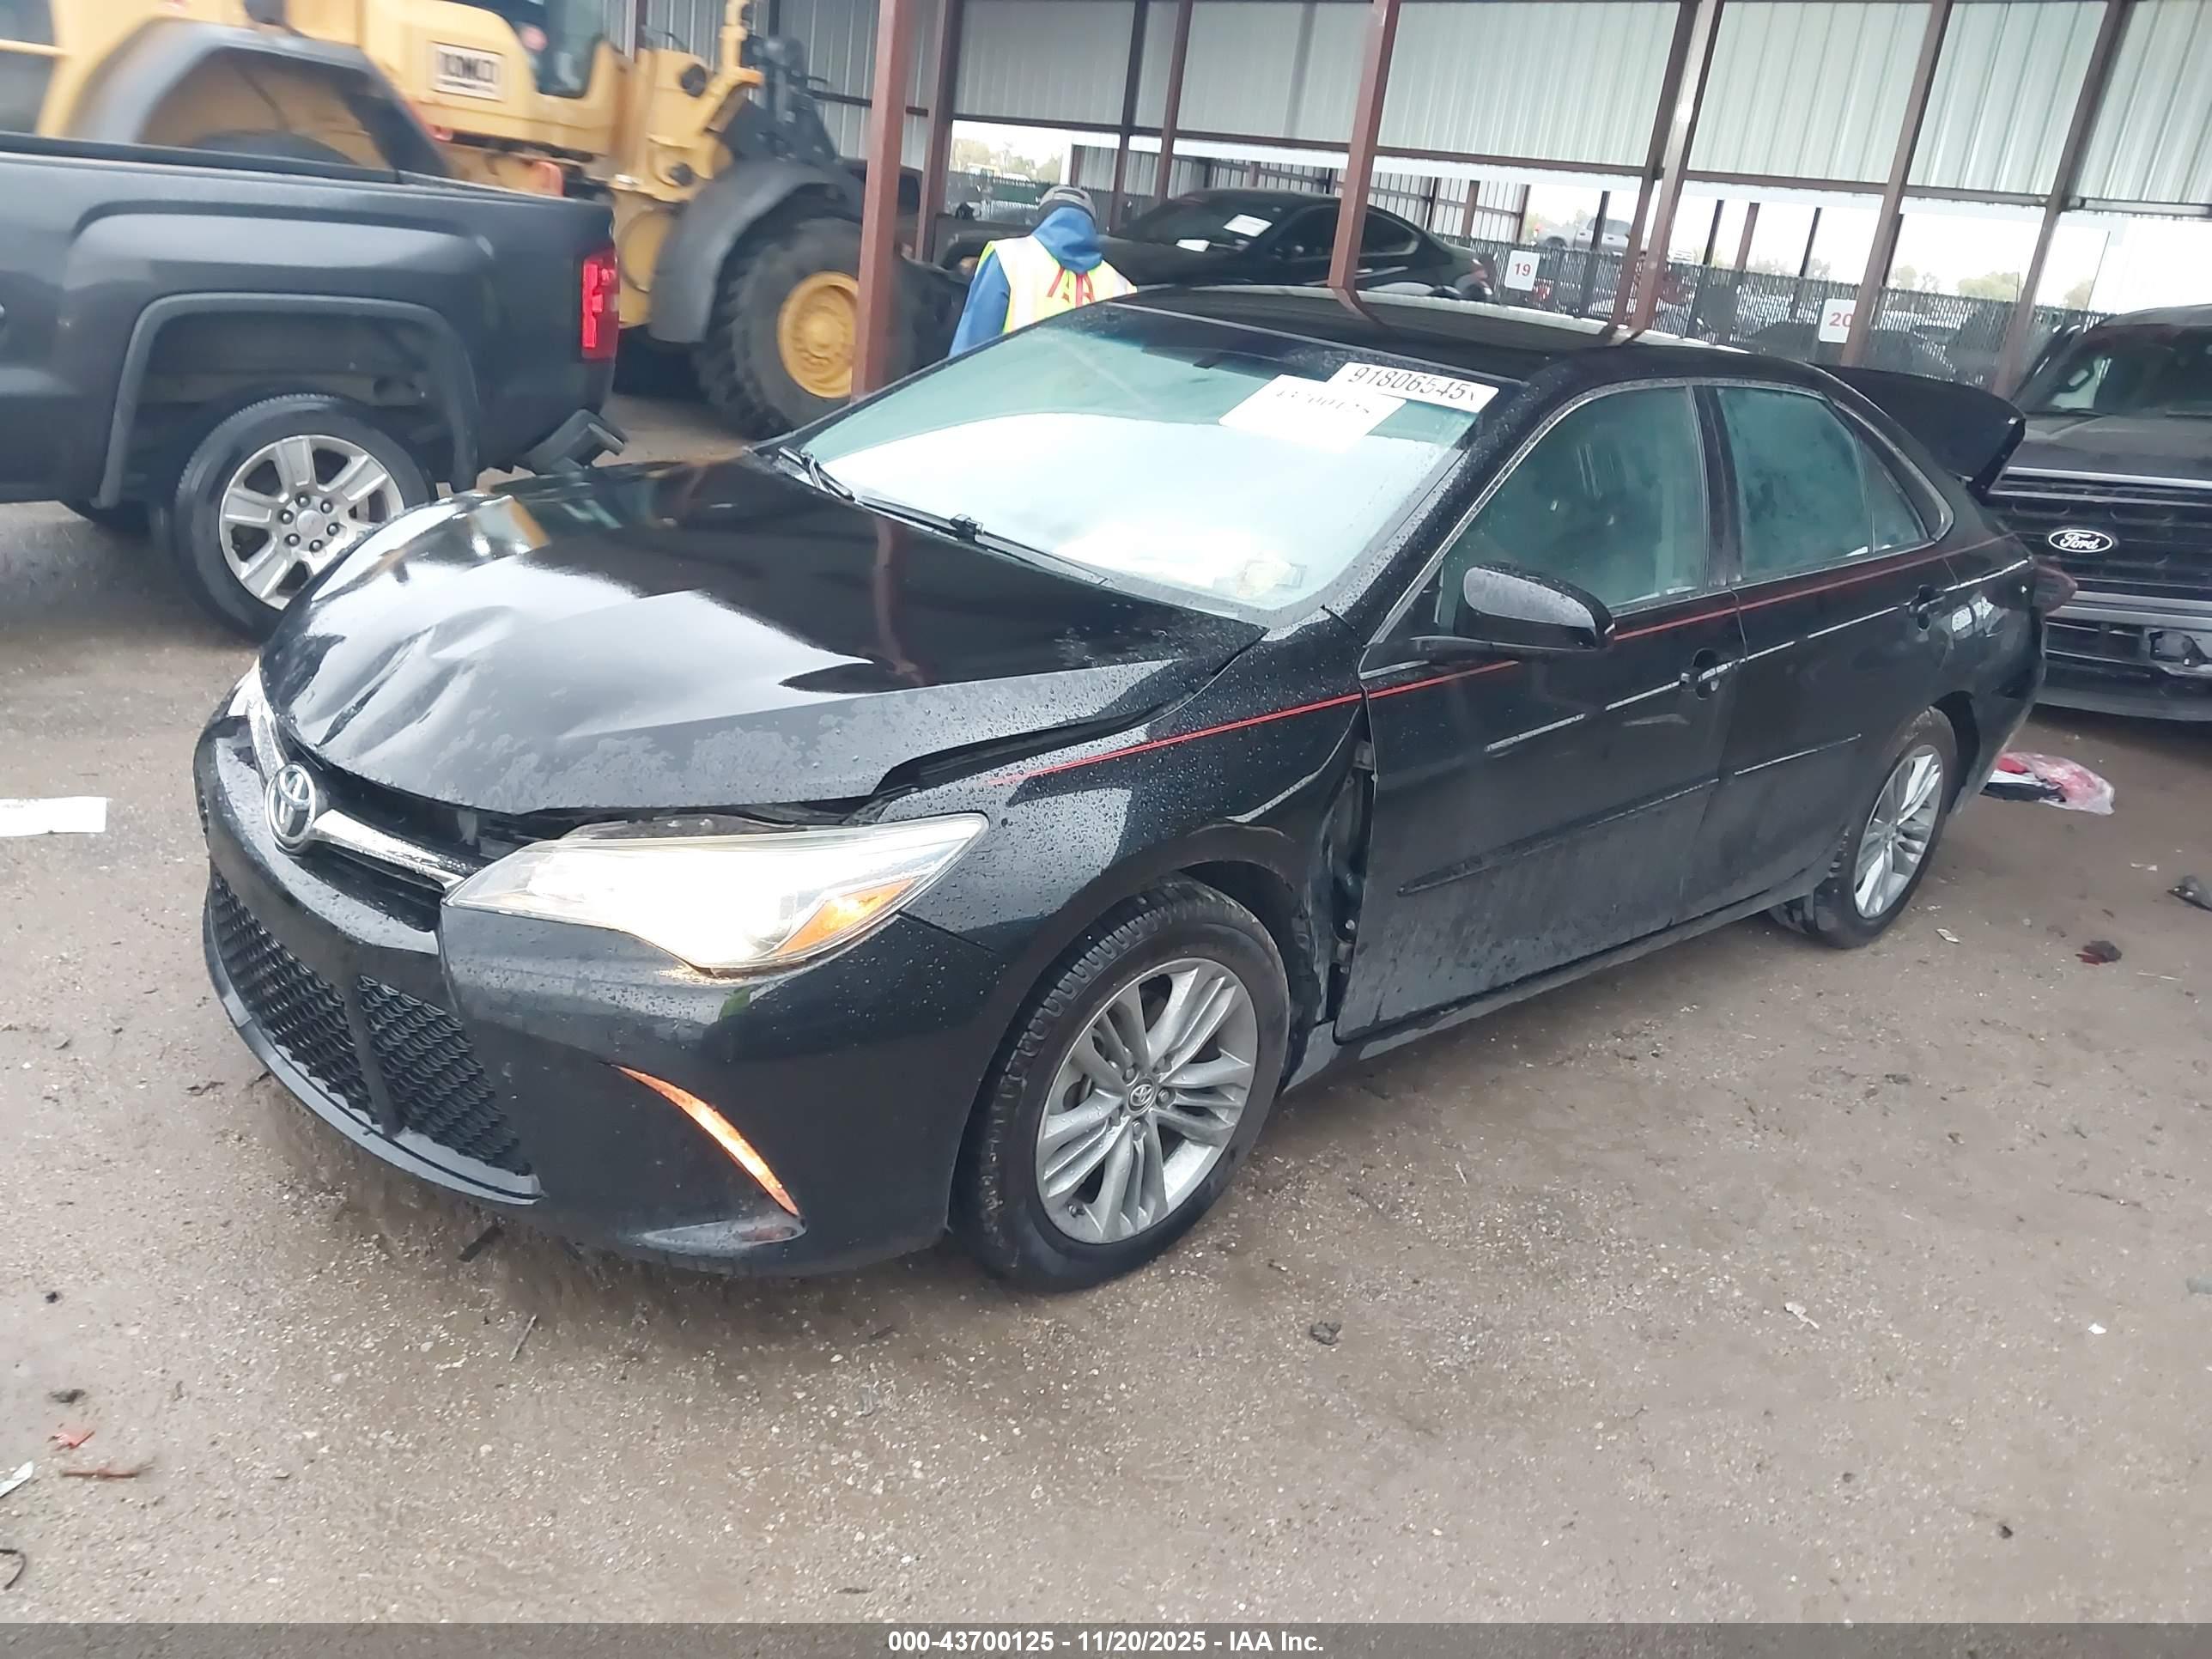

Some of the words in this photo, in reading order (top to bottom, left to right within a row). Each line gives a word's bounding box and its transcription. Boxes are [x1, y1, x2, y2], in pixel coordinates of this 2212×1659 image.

[1515, 263, 1531, 276] 19
[1829, 312, 1853, 327] 20
[2059, 532, 2100, 550] Ford
